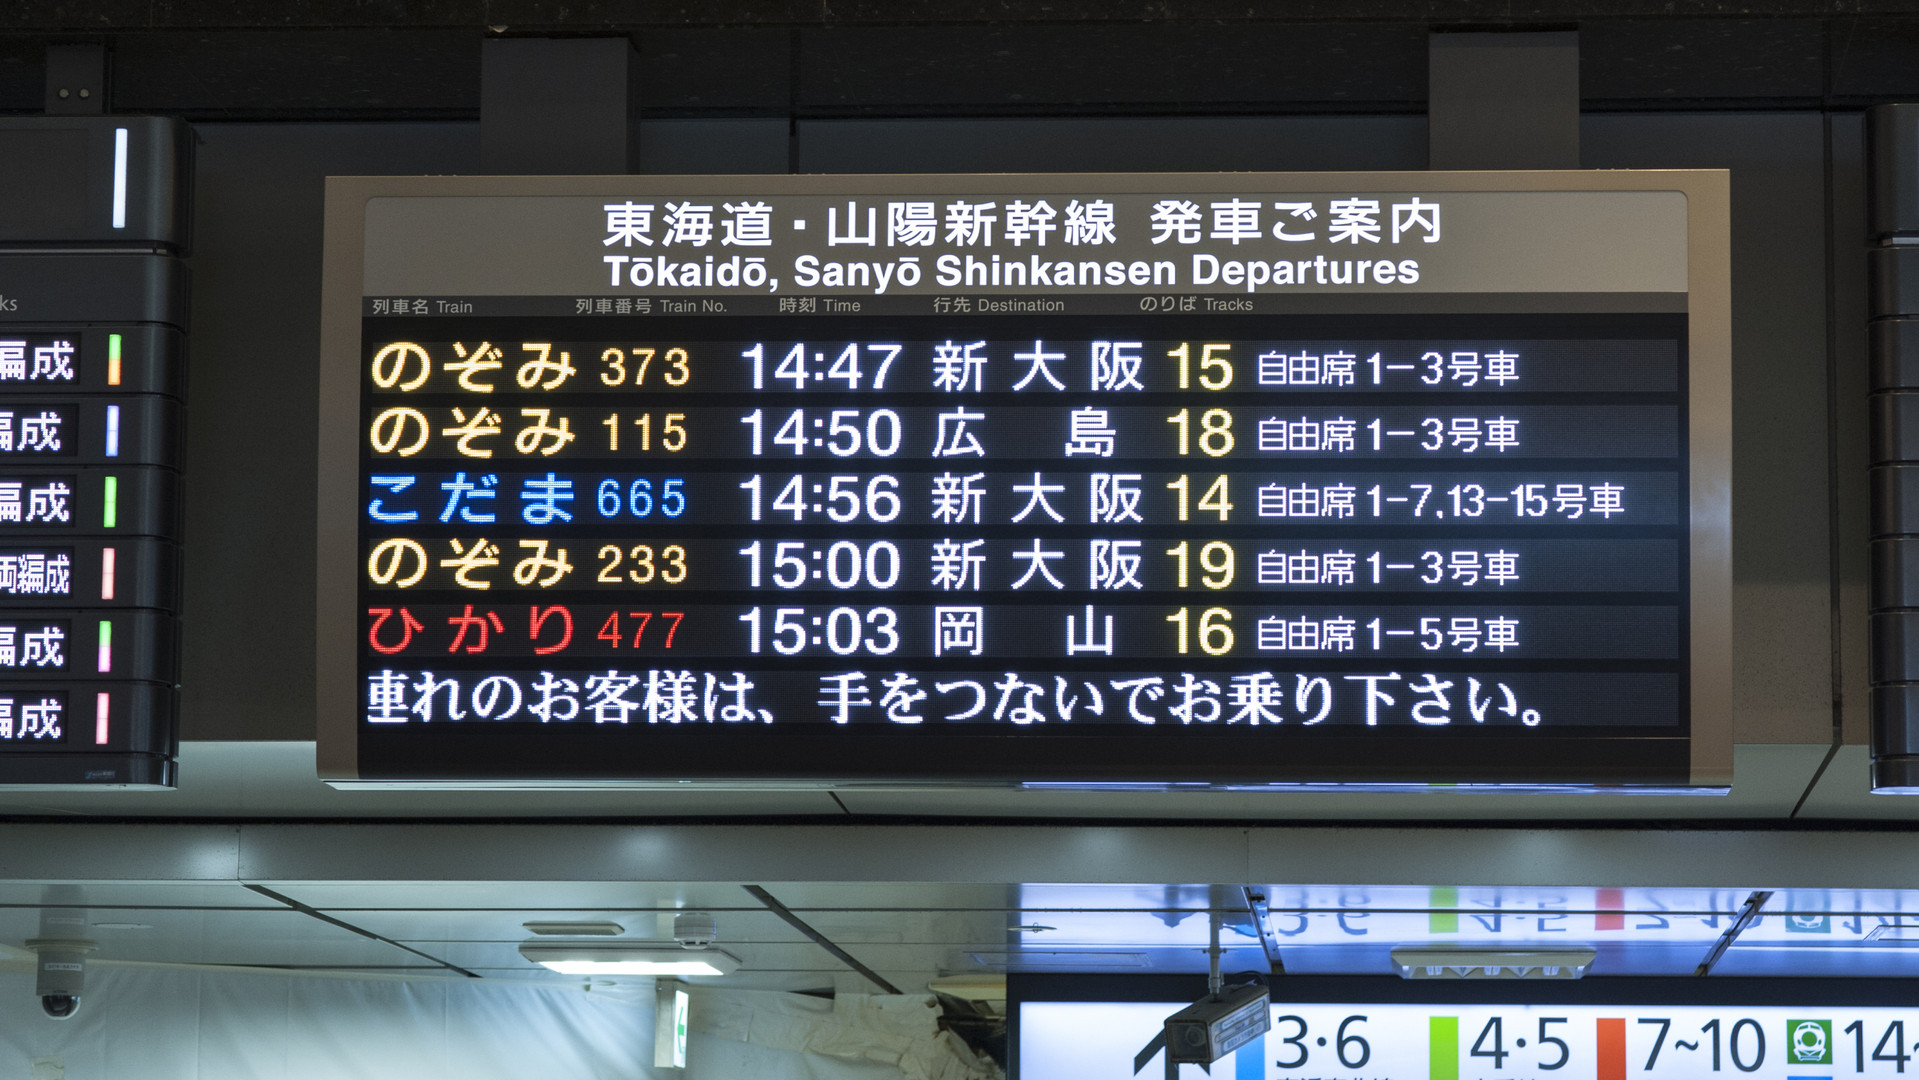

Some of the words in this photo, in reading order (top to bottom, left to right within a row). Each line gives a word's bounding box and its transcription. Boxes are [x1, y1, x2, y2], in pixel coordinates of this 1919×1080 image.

[603, 200, 1116, 247] 東海道・山陽新幹線
[1151, 198, 1440, 244] 発車ご案内
[604, 256, 777, 292] Tōkaidō,
[795, 255, 920, 294] Sanyō
[936, 255, 1175, 286] Shinkansen
[1193, 254, 1419, 292] Departures
[373, 299, 428, 314] 列車名
[437, 301, 472, 313] Train
[576, 299, 651, 313] 列車番号
[660, 300, 696, 312] Train
[703, 299, 728, 313] No.
[780, 297, 815, 312] 時刻
[824, 299, 860, 311] Time
[934, 297, 970, 312] 行先
[979, 299, 1064, 311] Destination
[1140, 297, 1196, 311] のりば
[1204, 298, 1253, 310] Tracks
[372, 342, 576, 393] のぞみ
[601, 348, 689, 386] 373
[741, 343, 902, 389] 14:47
[1167, 343, 1233, 390] 15
[371, 407, 575, 458] のぞみ
[603, 414, 686, 451] 115
[741, 408, 901, 457] 14:50
[1167, 409, 1234, 457] 18
[368, 472, 575, 525] こだま
[597, 478, 685, 518] 665
[739, 474, 901, 523] 14:56
[1167, 475, 1233, 521] 14
[369, 538, 573, 590] のぞみ
[598, 545, 687, 583] 233
[739, 540, 900, 589] 15:00
[1167, 541, 1234, 589] 19
[369, 605, 573, 654] ひかり
[598, 612, 684, 648] 477
[739, 607, 899, 655] 15:03
[1166, 607, 1234, 655] 16
[1845, 1021, 1919, 1072] 14
